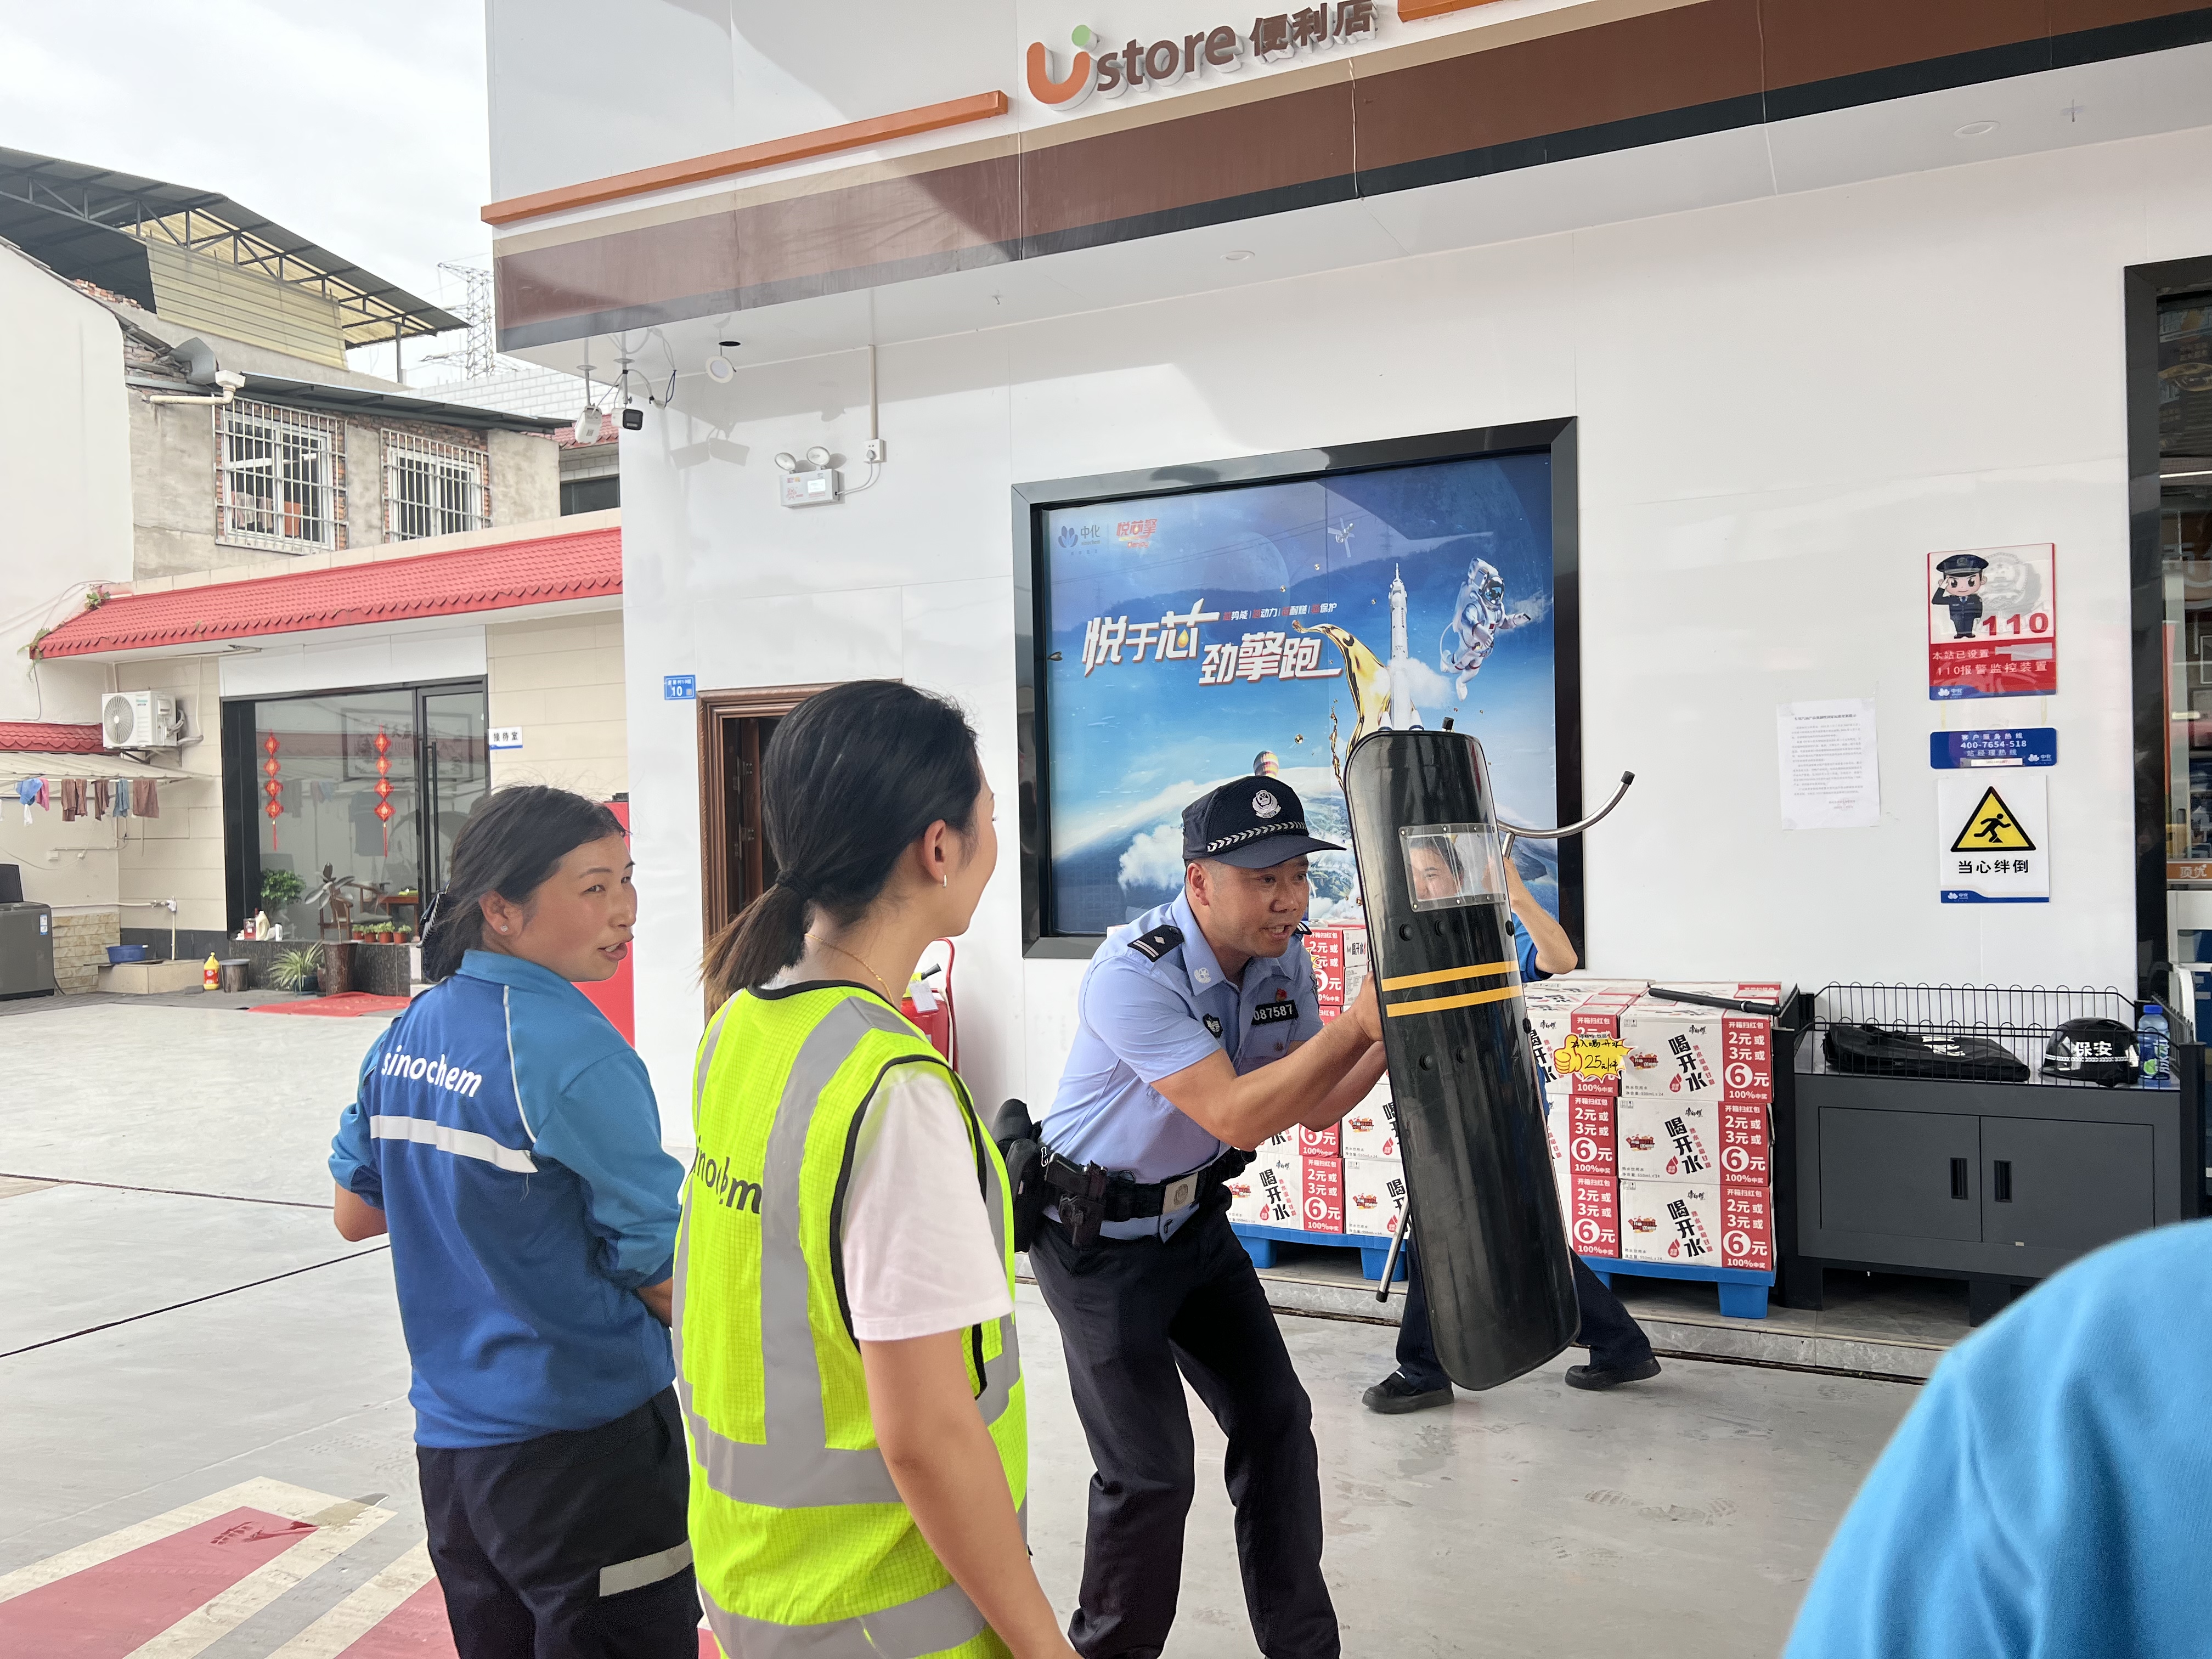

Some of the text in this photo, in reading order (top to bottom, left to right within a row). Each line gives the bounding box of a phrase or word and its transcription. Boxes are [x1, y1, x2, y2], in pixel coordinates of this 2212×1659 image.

[1249, 0, 1376, 57] 便利店
[1081, 524, 1101, 539] 中化
[1983, 612, 2049, 636] 110
[1081, 597, 1221, 678] 悦于芯
[1198, 631, 1344, 686] 劲擎跑
[1932, 648, 1989, 660] 本站已设置
[1938, 661, 2047, 675] 110报警监控装置
[671, 686, 682, 696] 10
[493, 731, 518, 742] 接待室
[1961, 732, 2023, 741] 客户服务热线
[1960, 741, 2027, 749] 400-7654-518
[1958, 859, 2029, 874] 当心绊倒
[1577, 1017, 1610, 1025] 开箱扫红包
[2074, 1041, 2113, 1057] 保安
[1668, 1034, 1707, 1091] 喝开水
[381, 1045, 482, 1098] sinochem
[1577, 1084, 1613, 1093] 100%中奖
[1729, 1091, 1767, 1099] 100%中奖
[1575, 1097, 1608, 1106] 开箱扫红包
[1664, 1117, 1703, 1174] 喝开水
[1308, 1159, 1336, 1167] 开箱扫红包
[1575, 1164, 1611, 1173] 100%中奖
[1577, 1178, 1610, 1187] 开箱扫红包
[1726, 1174, 1763, 1183] 100%中奖
[1259, 1169, 1290, 1221] 喝开水
[1728, 1189, 1762, 1197] 开箱扫红包
[1308, 1222, 1339, 1231] 100%中奖
[1667, 1199, 1706, 1257] 喝开水
[1578, 1245, 1613, 1255] 100%中奖
[1728, 1258, 1765, 1268] 100%中奖
